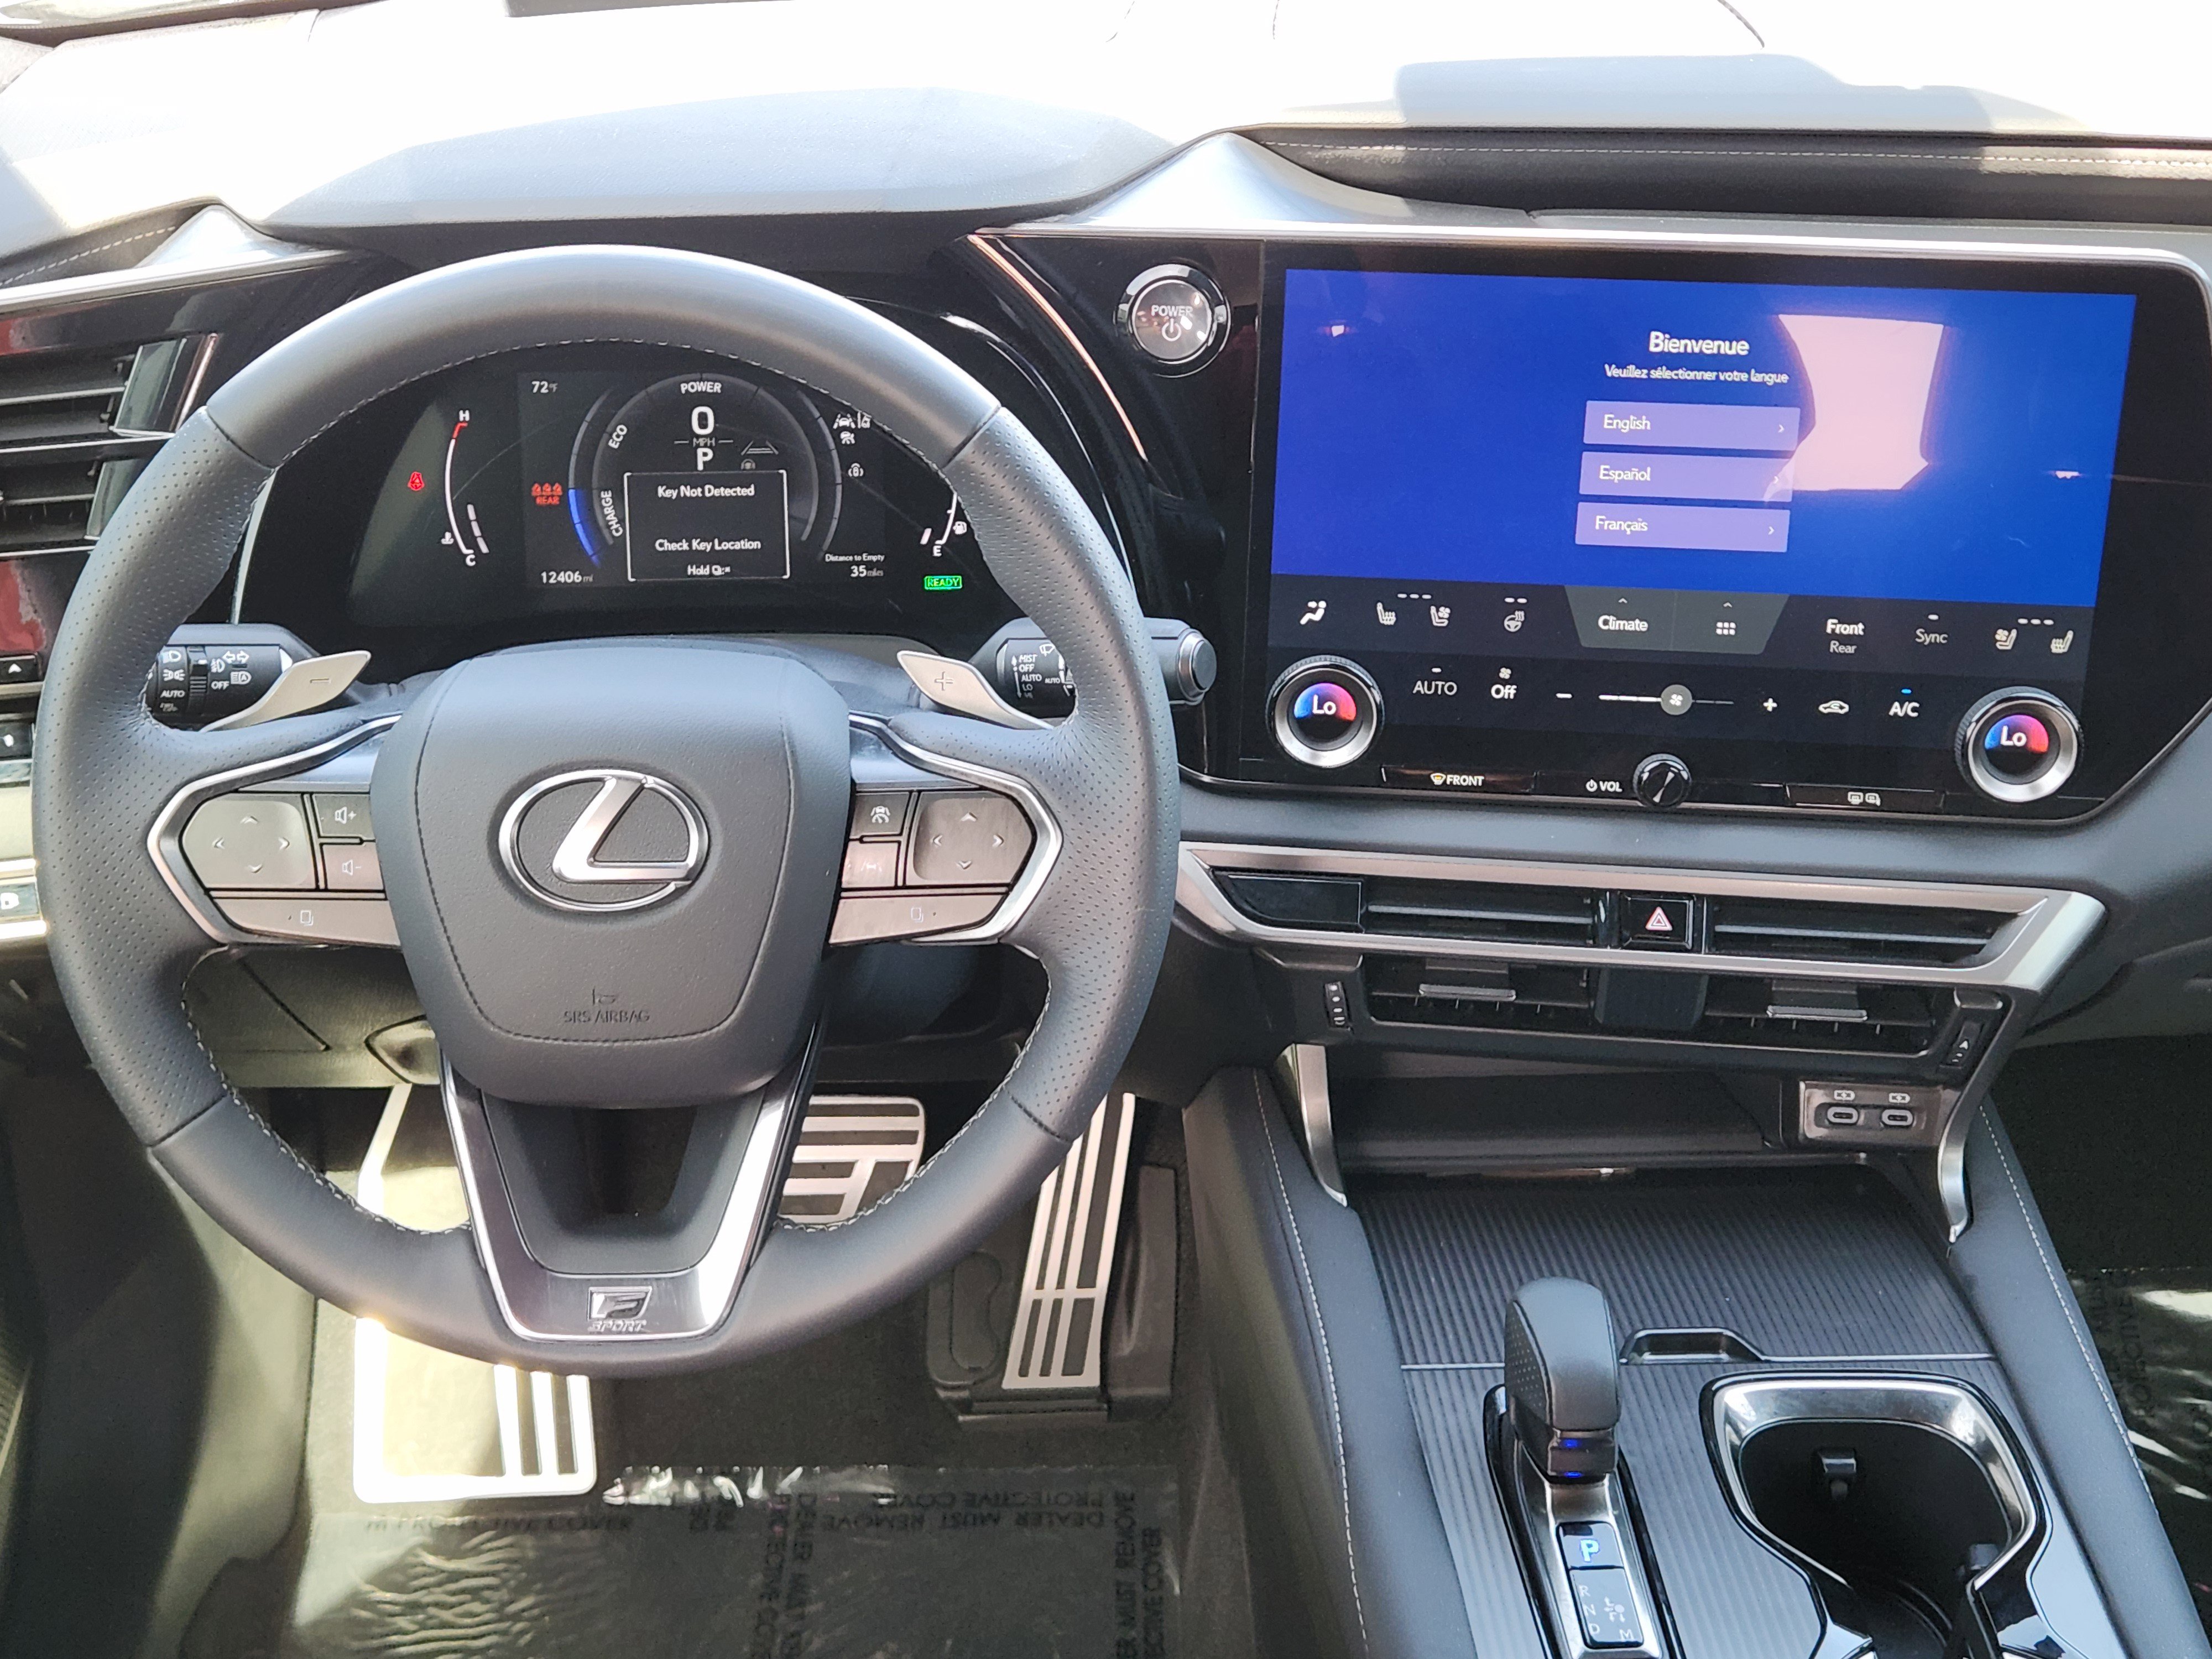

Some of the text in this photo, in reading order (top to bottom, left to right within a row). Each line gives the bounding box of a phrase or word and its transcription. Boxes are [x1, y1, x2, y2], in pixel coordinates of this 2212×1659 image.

[1151, 305, 1193, 317] POWER
[1648, 331, 1750, 355] Bienvenue
[1604, 364, 1789, 385] Veuillez sélectionner votre langue
[681, 381, 722, 394] POWER
[459, 410, 469, 421] H
[691, 406, 714, 435] 0
[1603, 414, 1651, 433] English
[608, 425, 628, 449] ECO
[692, 437, 715, 446] MPH
[697, 447, 713, 471] P
[1599, 465, 1651, 483] Español
[658, 483, 755, 499] Key Not Detected
[536, 497, 560, 505] REAR
[601, 490, 623, 537] CHARGE
[1595, 515, 1648, 535] Français
[655, 538, 761, 552] Check Key Location
[932, 545, 942, 557] E
[466, 554, 476, 566] C
[825, 554, 853, 562] Distance
[863, 553, 885, 562] Empty
[687, 565, 710, 575] Hold
[851, 565, 867, 577] 35
[927, 578, 959, 587] READY
[1598, 614, 1648, 632] Climate
[1826, 618, 1865, 636] Front
[1915, 629, 1948, 645] Sync
[1829, 640, 1858, 654] Rear
[1019, 654, 1038, 663] MIST
[1019, 664, 1035, 672] OFF
[1021, 674, 1042, 682] AUTO
[211, 681, 229, 690] OFF
[1412, 680, 1458, 696] AUTO
[1491, 684, 1517, 700] Off
[160, 690, 185, 698] AUTO
[1312, 695, 1337, 716] Lo
[1888, 701, 1919, 717] A/C
[2000, 726, 2027, 747] Lo
[1446, 775, 1484, 787] FRONT
[1599, 781, 1623, 793] VOL
[564, 1010, 650, 1024] SRS AIRBAG
[587, 1319, 647, 1332] SPORT
[1579, 1539, 1600, 1562] P
[1579, 1585, 1590, 1598] R
[1583, 1604, 1595, 1616] N
[1589, 1623, 1600, 1635] D
[1619, 1629, 1635, 1642] M
